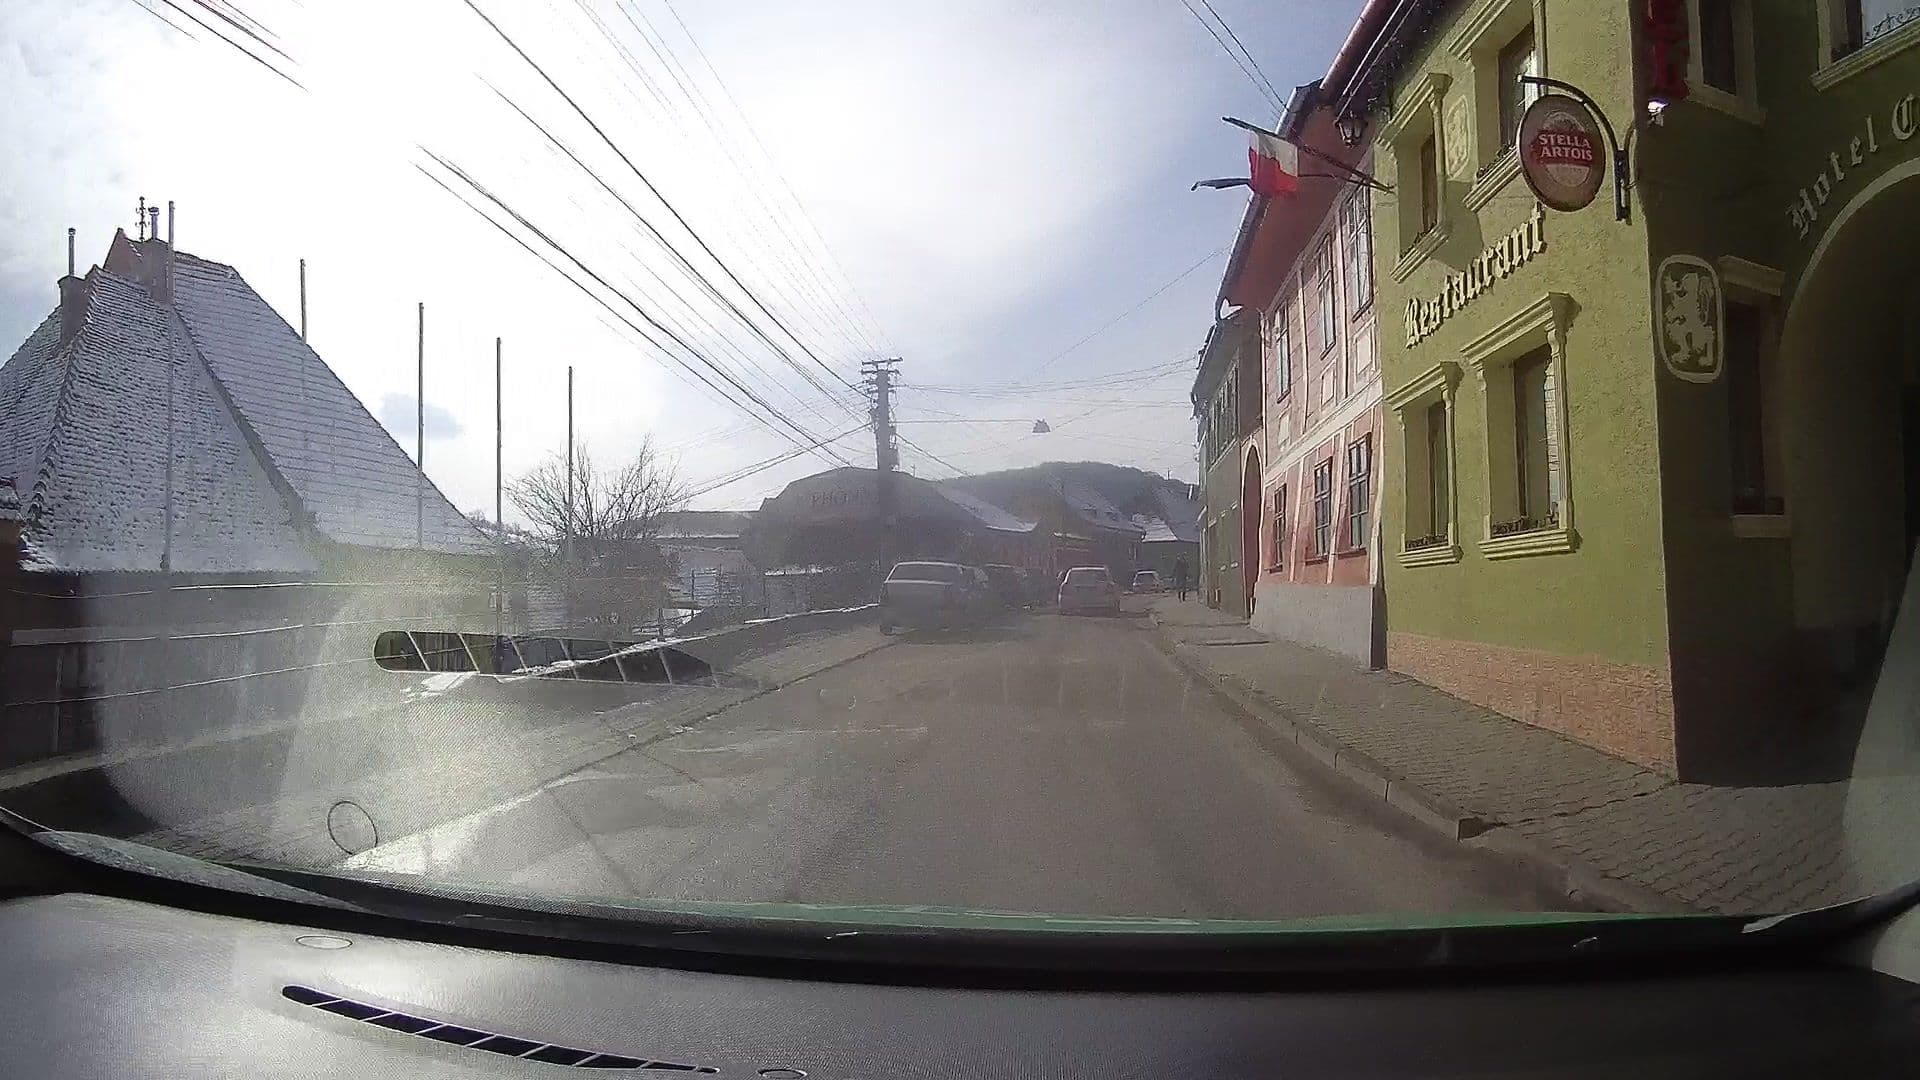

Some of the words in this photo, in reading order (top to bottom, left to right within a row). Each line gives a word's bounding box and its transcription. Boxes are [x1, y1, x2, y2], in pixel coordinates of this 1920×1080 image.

[1538, 133, 1592, 149] STELLA
[1540, 147, 1593, 161] ARTOIS
[1785, 115, 1879, 240] Hotel
[1403, 201, 1546, 349] Restaurant
